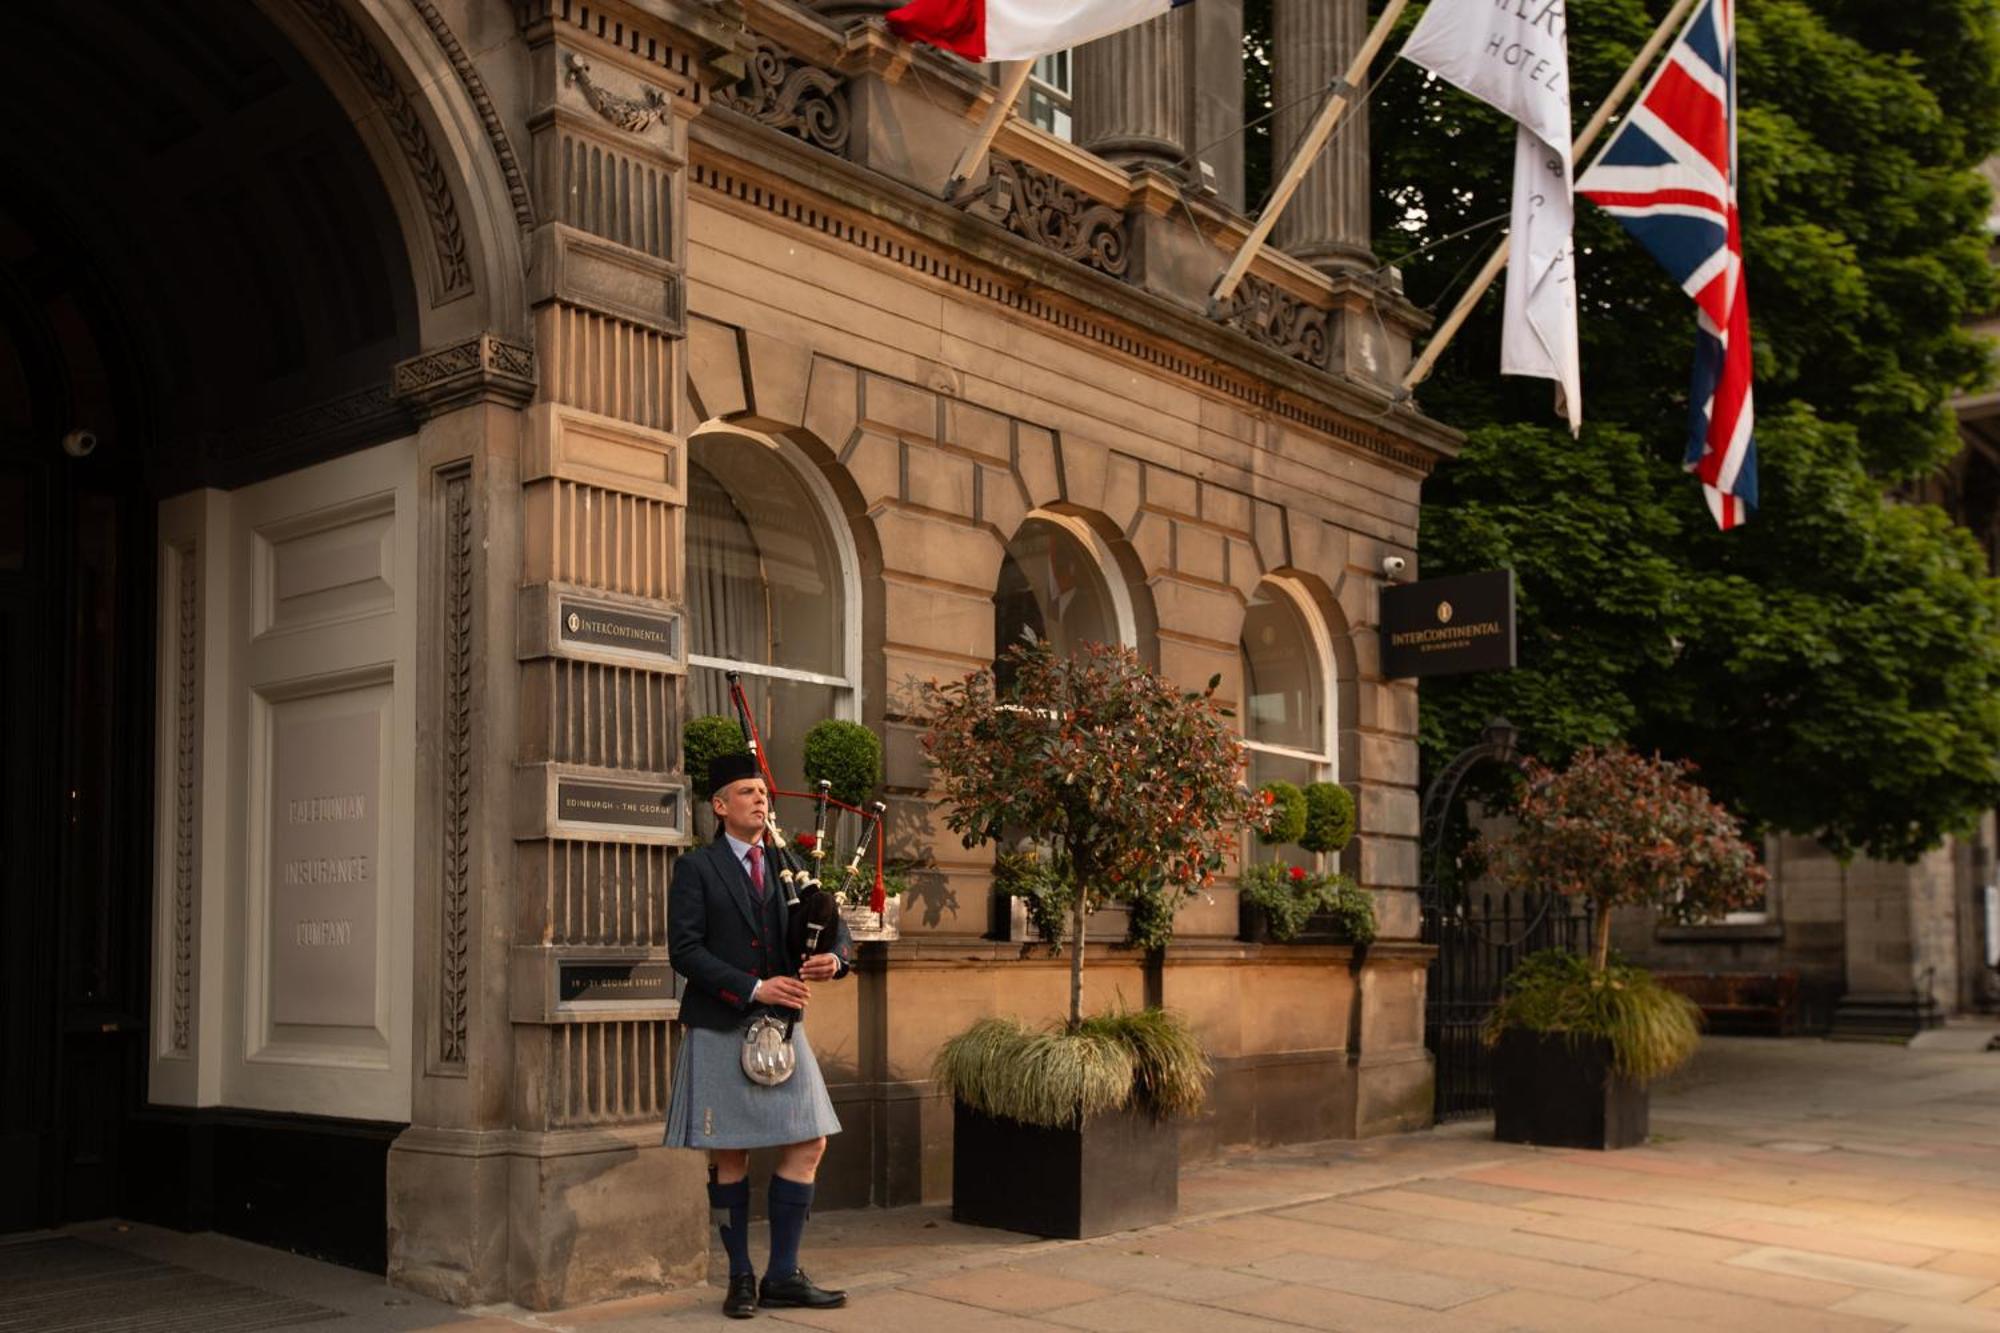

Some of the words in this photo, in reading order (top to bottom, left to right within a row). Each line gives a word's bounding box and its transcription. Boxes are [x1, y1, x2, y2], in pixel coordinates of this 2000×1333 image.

[581, 620, 666, 641] INTERCONTINENTAL
[1392, 622, 1500, 645] INTERCONTINENTAL
[289, 795, 365, 823] CALEDONIAN
[567, 799, 613, 809] EDINBURGH
[622, 803, 637, 812] THE
[639, 804, 671, 814] GEORGE
[286, 857, 368, 884] INSURANCE
[297, 919, 352, 945] COMPANY
[635, 978, 662, 987] STREET
